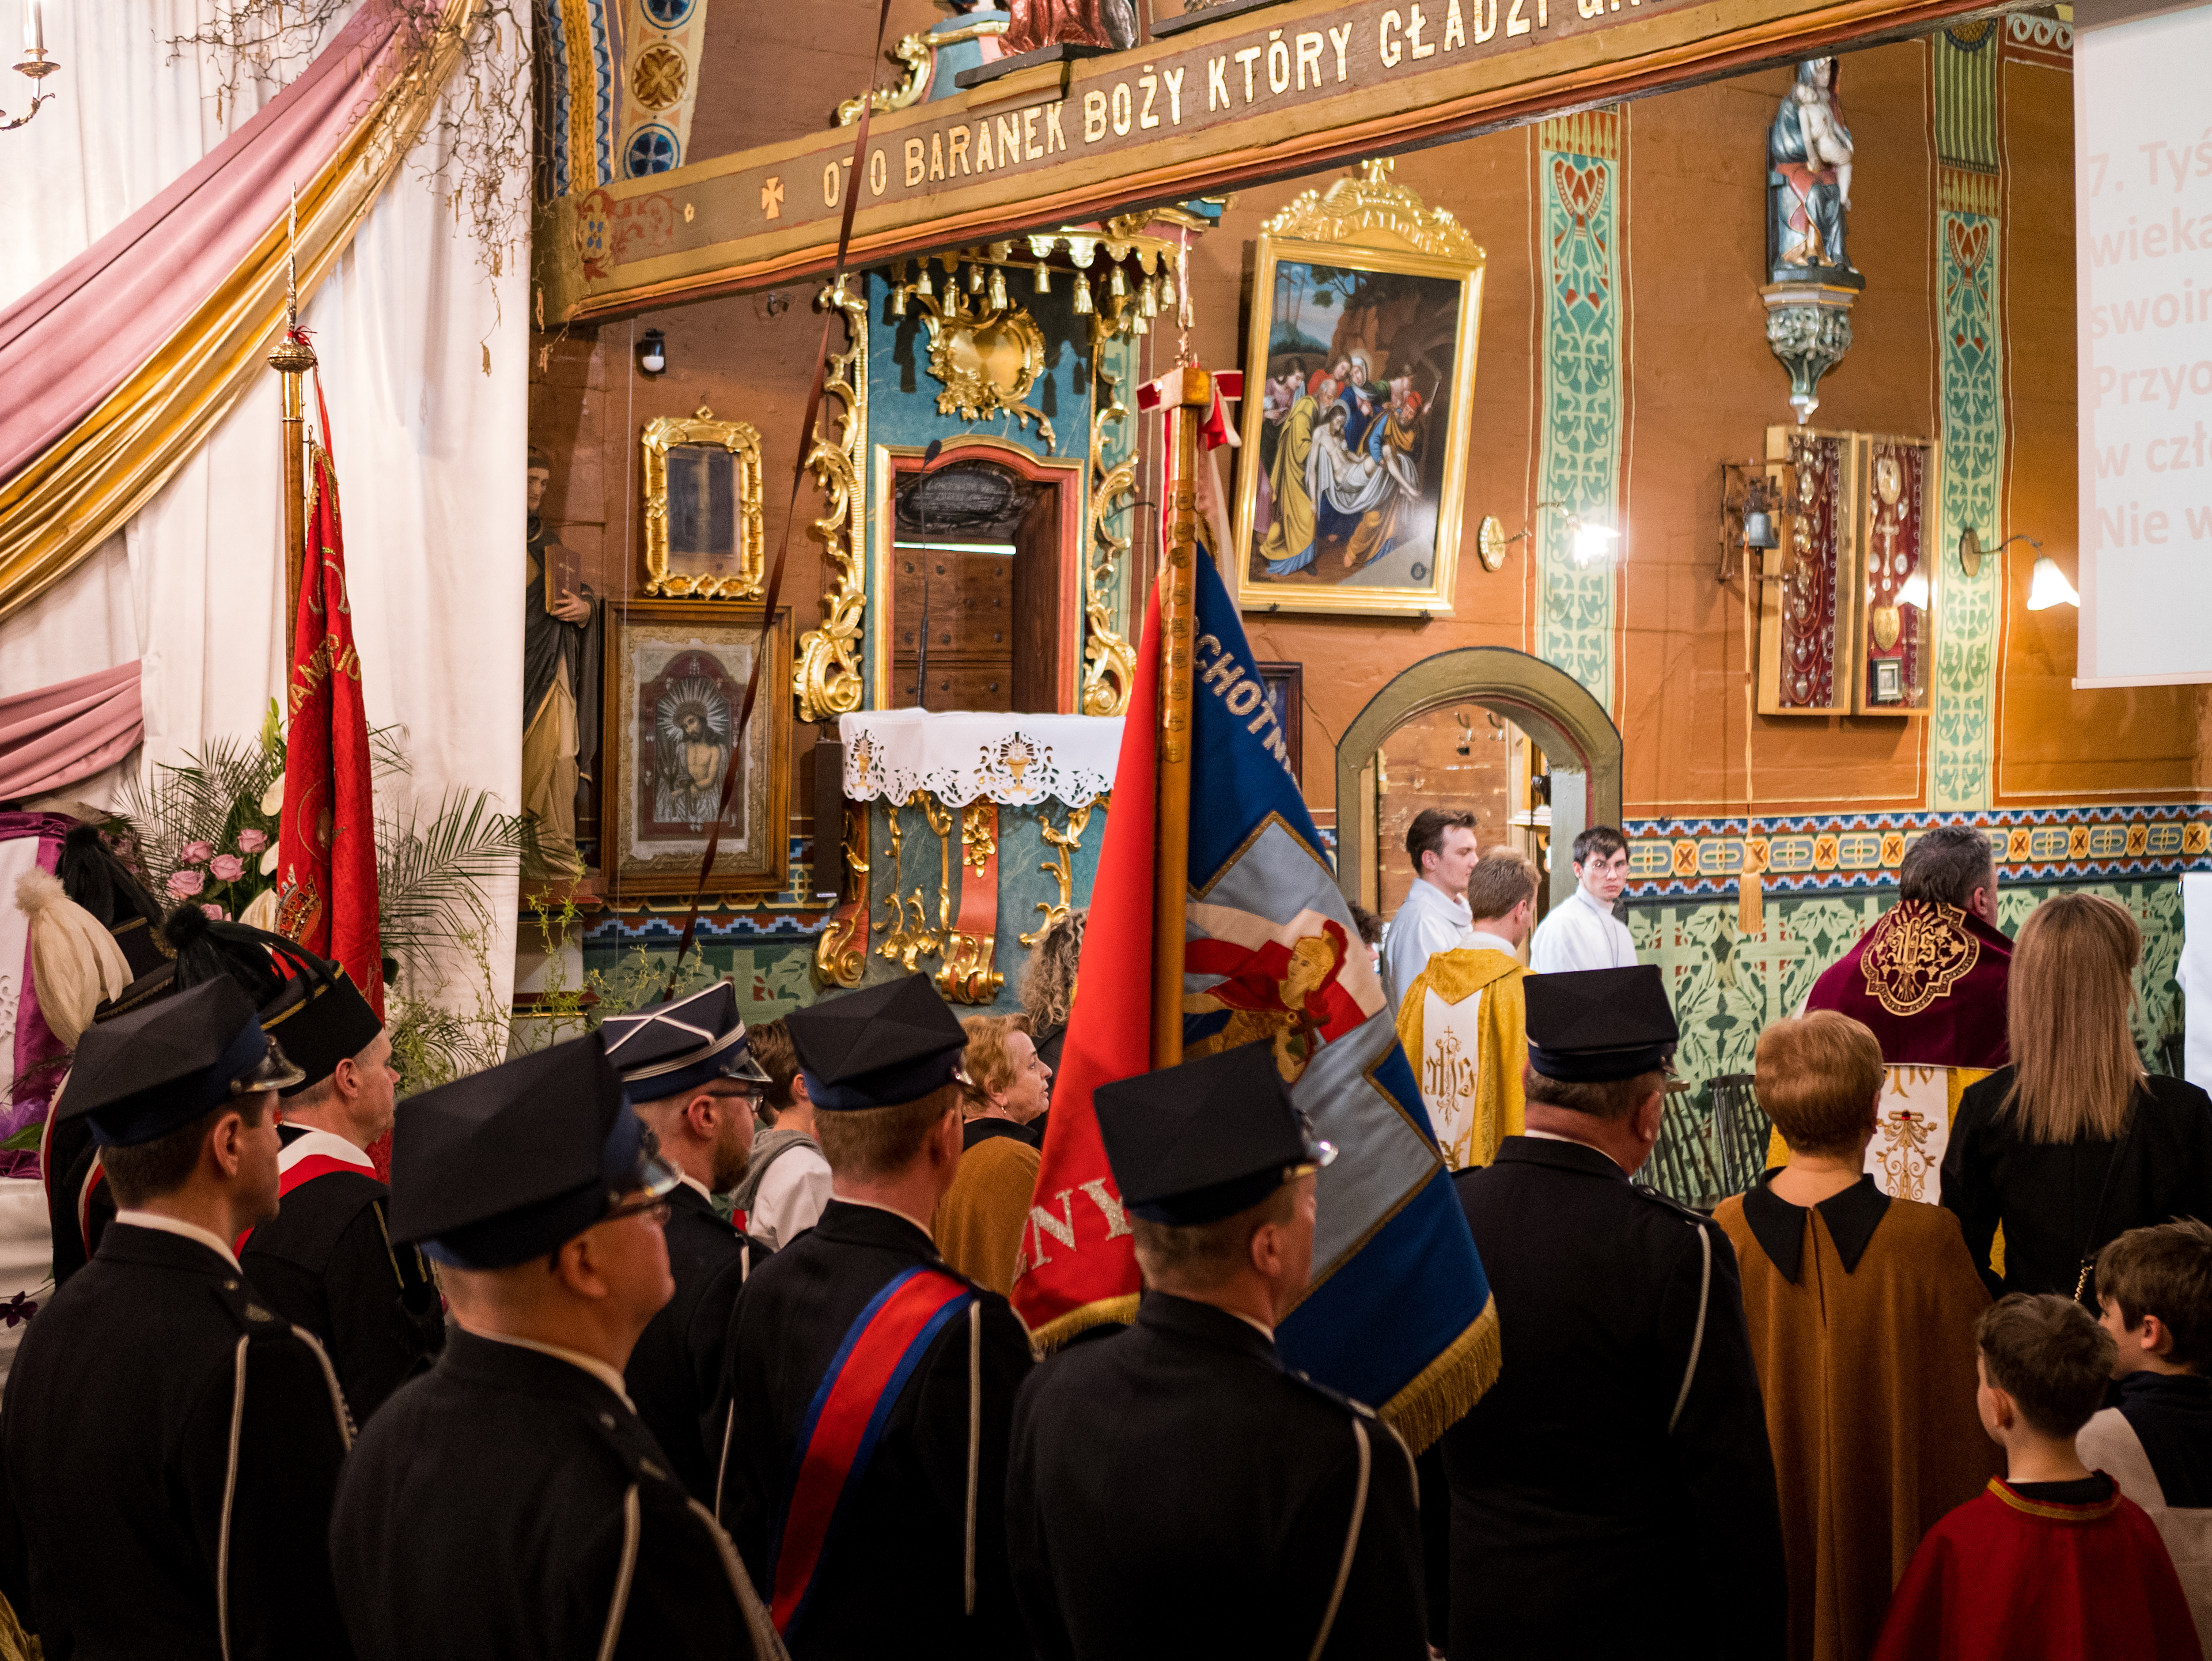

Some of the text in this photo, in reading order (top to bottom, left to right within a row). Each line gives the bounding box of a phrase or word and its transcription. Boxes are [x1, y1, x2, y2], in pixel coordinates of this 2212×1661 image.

[823, 149, 887, 208] OO
[905, 101, 1067, 188] BARANEK
[1084, 65, 1185, 144] BOŻY
[1207, 22, 1353, 112] KTÓRY
[2145, 420, 2212, 473] czł
